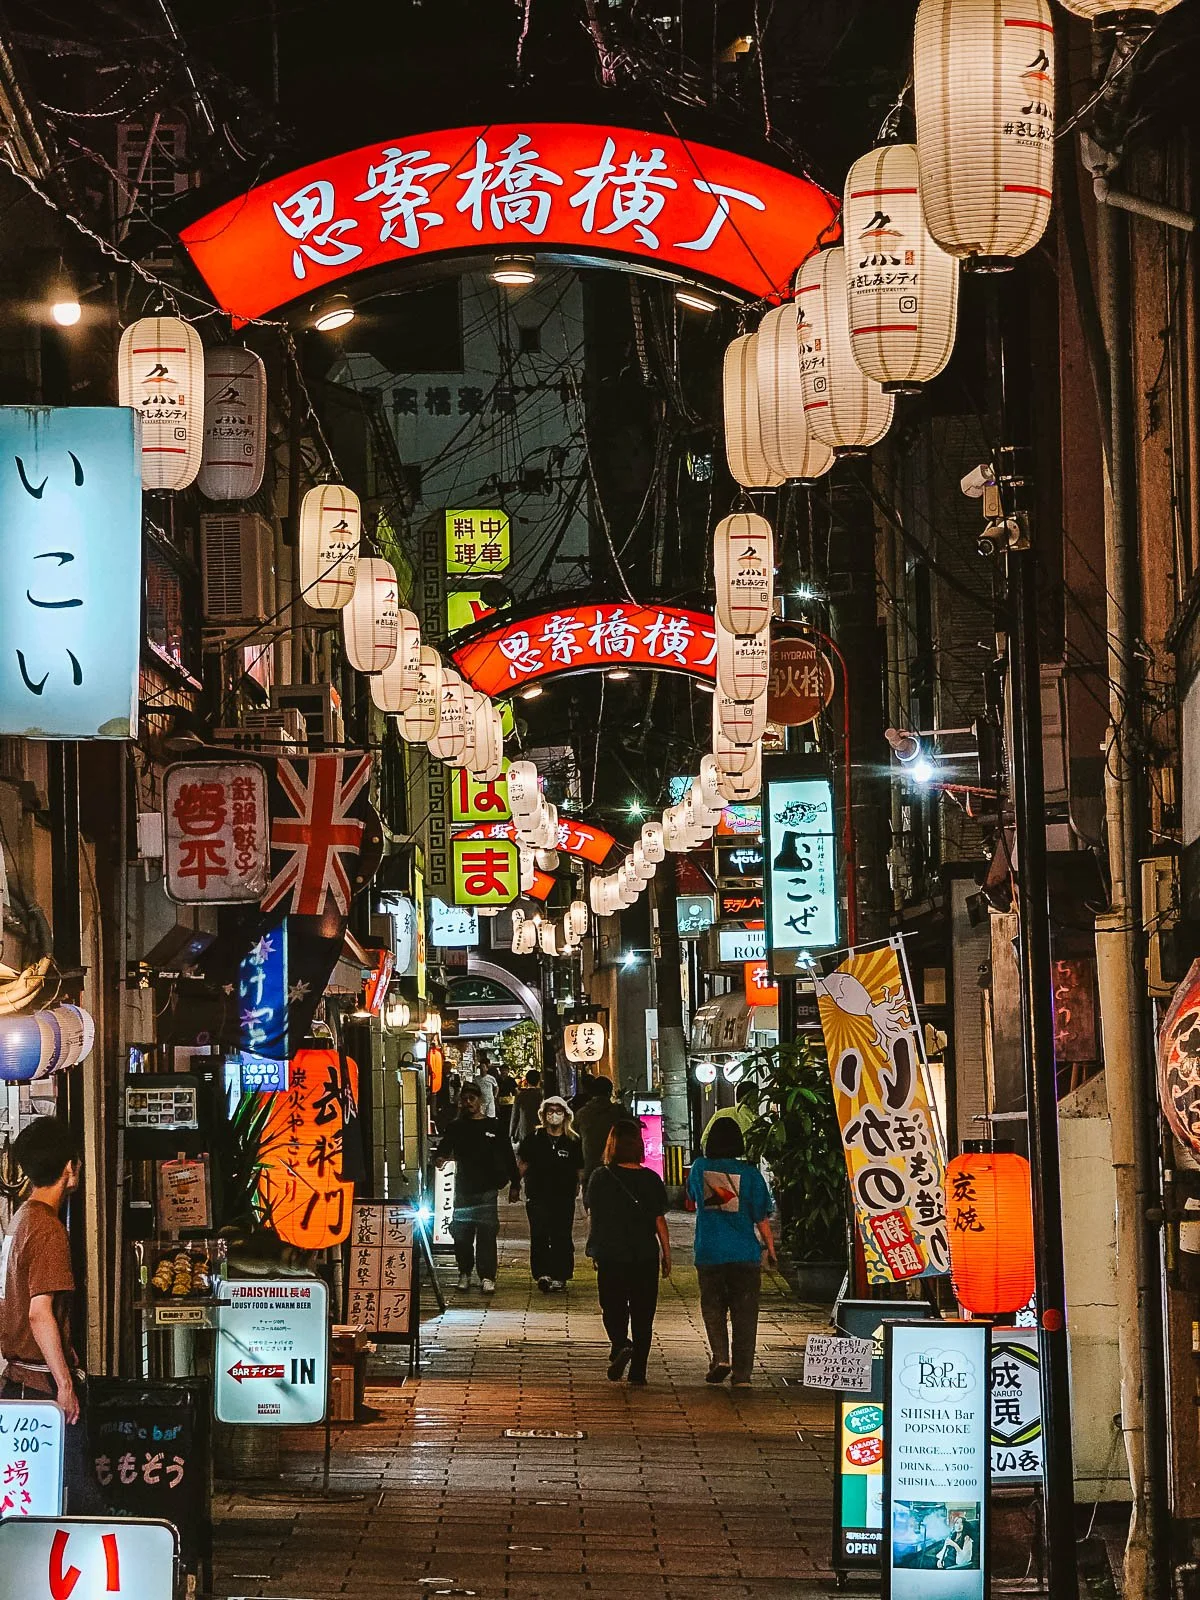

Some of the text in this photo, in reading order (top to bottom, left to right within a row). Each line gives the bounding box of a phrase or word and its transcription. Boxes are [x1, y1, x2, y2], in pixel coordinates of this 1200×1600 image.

[14, 450, 85, 695] いこい
[951, 1172, 985, 1233] 炭焼
[231, 1302, 252, 1310] LOUSY
[252, 1302, 269, 1310] FOOD
[275, 1302, 295, 1310] WARM
[232, 1367, 250, 1376] BAR
[290, 1358, 316, 1385] IN
[900, 1408, 975, 1420] SHISHA Bar
[904, 1423, 971, 1434] POPSMOKE
[95, 1452, 185, 1489] ももぞう
[845, 1542, 877, 1555] OPEN
